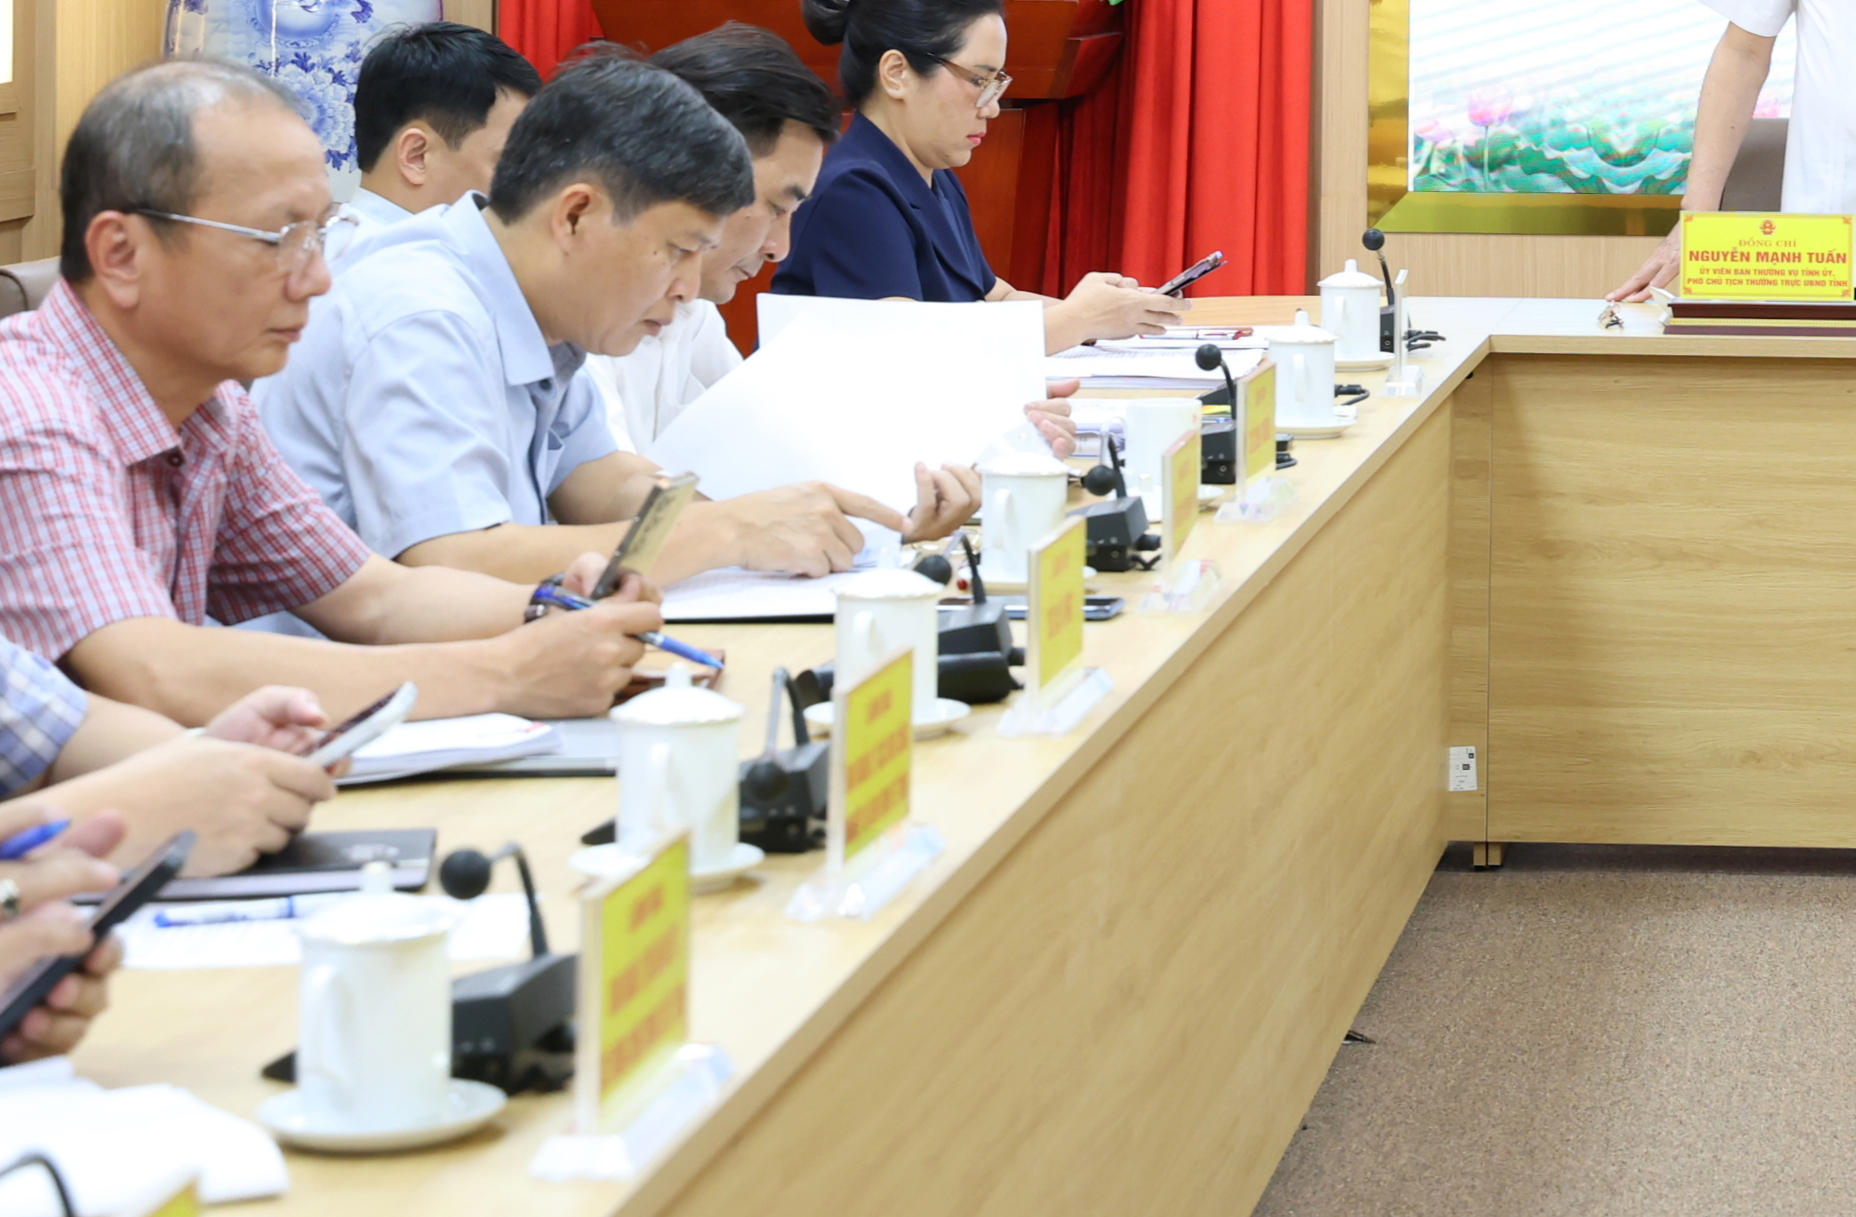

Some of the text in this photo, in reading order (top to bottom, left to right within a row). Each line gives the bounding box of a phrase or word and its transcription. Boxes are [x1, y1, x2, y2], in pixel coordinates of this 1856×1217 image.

[1776, 238, 1797, 248] CHÍ
[1689, 247, 1847, 265] NGUYỄN MẠNH TUẤN
[1699, 266, 1710, 275] ỦY
[1712, 267, 1732, 275] VIÊN
[1733, 268, 1751, 276] BAN
[1753, 267, 1785, 276] THƯỜNG
[1788, 269, 1799, 277] VỤ
[1801, 268, 1820, 277] TỈNH
[1687, 277, 1704, 285] PHÓ
[1706, 276, 1723, 285] CHỦ
[1725, 278, 1743, 286] TỊCH
[1746, 277, 1778, 286] THƯỜNG
[1781, 279, 1801, 288] TRỰC
[1829, 278, 1848, 287] TỈNH
